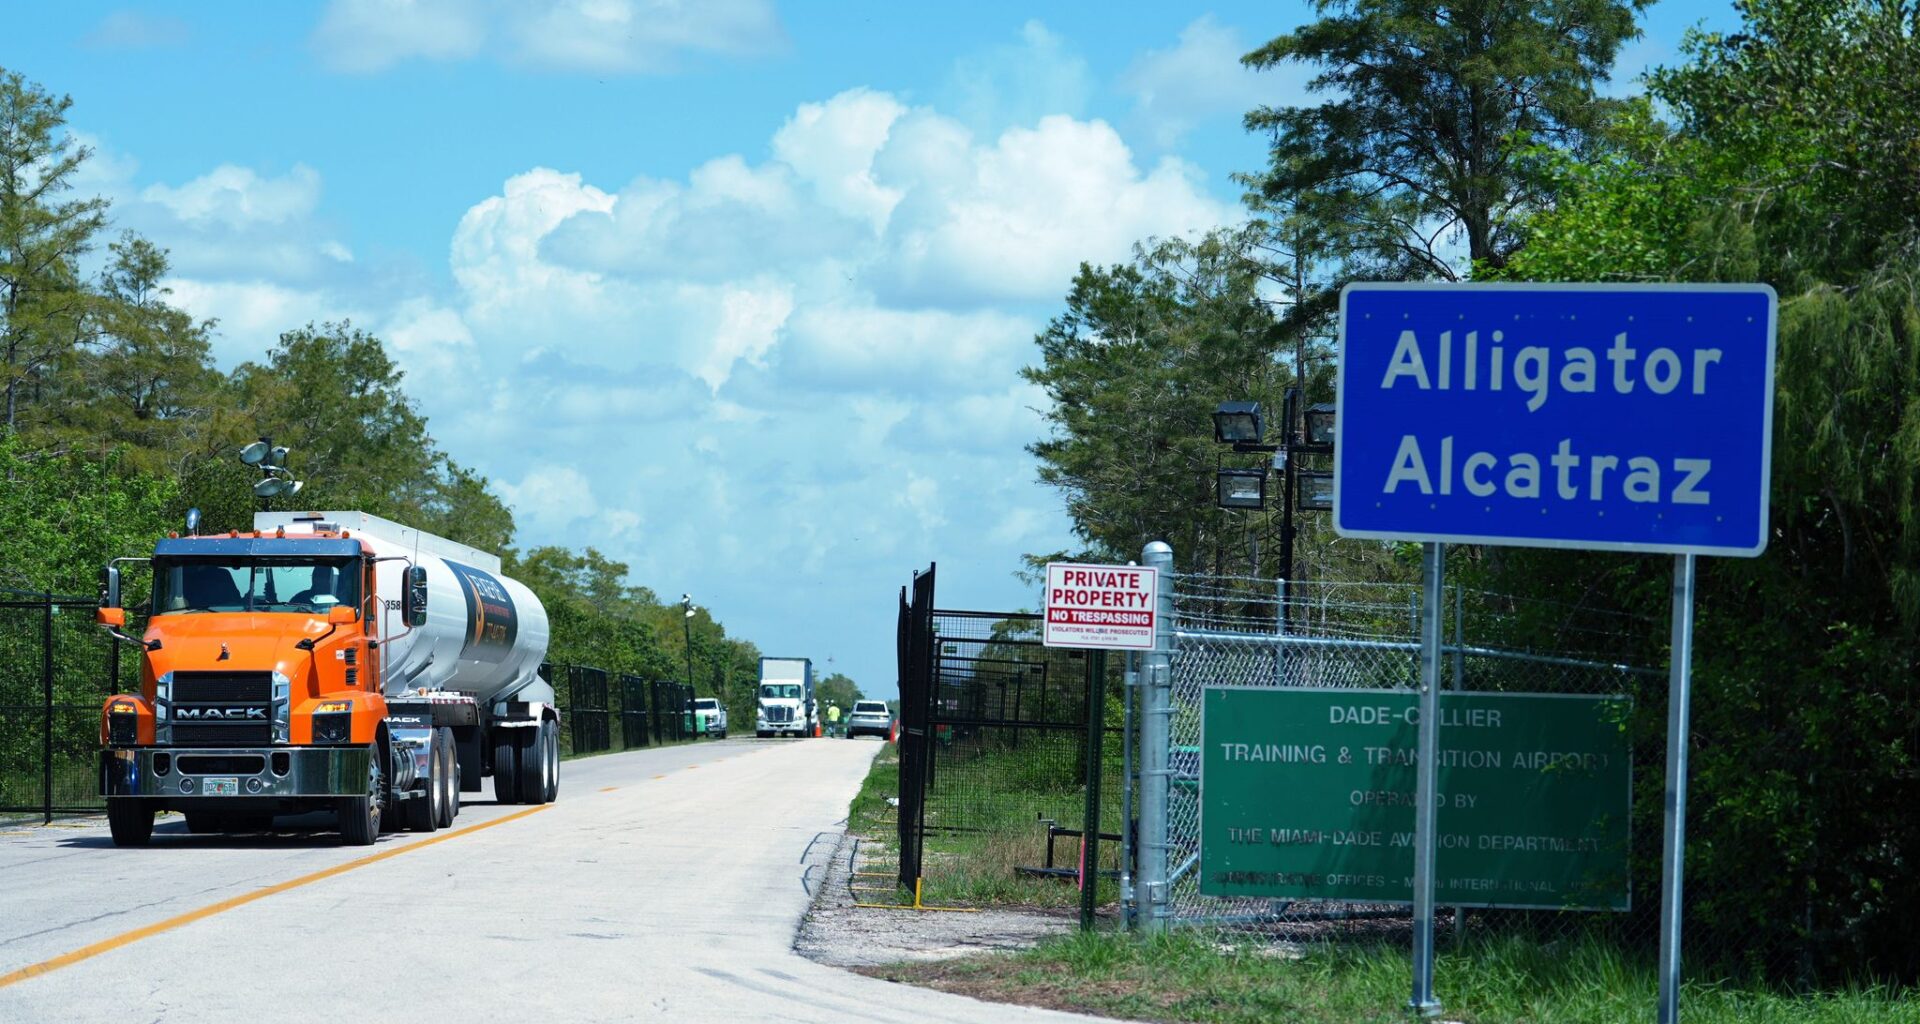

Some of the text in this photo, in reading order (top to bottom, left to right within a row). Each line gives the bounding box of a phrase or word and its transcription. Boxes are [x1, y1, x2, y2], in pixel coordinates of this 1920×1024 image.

[1380, 330, 1723, 413] Alligator
[1382, 435, 1712, 504] Alcatraz
[1063, 570, 1140, 589] PRIVATE
[1052, 589, 1149, 608] PROPERTY
[1051, 610, 1150, 625] NO TRESPASSING
[176, 707, 267, 720] MACK
[1329, 705, 1501, 728] DADE-CLLIER
[1220, 743, 1327, 764] TRAINING
[1336, 745, 1353, 765] &
[1363, 746, 1501, 769] TRANITION
[1349, 790, 1478, 809] OPERATD BY
[1227, 827, 1600, 853] THE MIAMI-DADE AVIION DEPARTMENT
[1326, 872, 1385, 888] OFFICES
